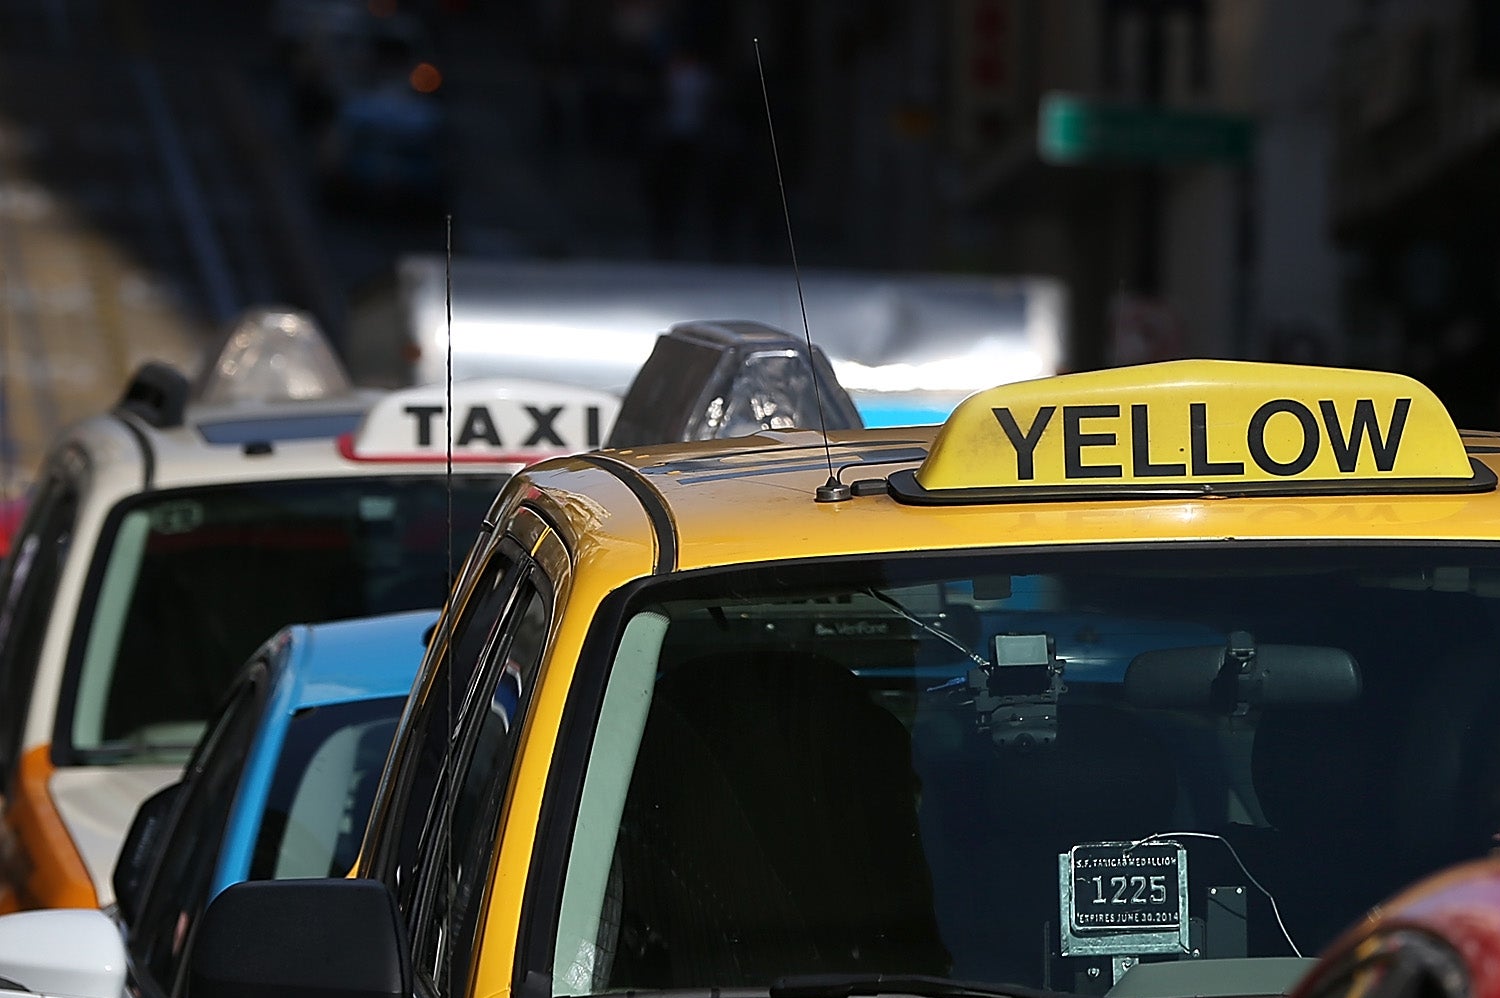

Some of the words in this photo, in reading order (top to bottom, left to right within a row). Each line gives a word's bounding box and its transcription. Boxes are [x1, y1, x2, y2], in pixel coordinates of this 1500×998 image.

[404, 406, 601, 446] TAXI
[991, 398, 1412, 481] YELLOW
[1092, 875, 1167, 905] 1225
[1079, 913, 1115, 923] EXPIRES
[1117, 912, 1139, 922] JUNE
